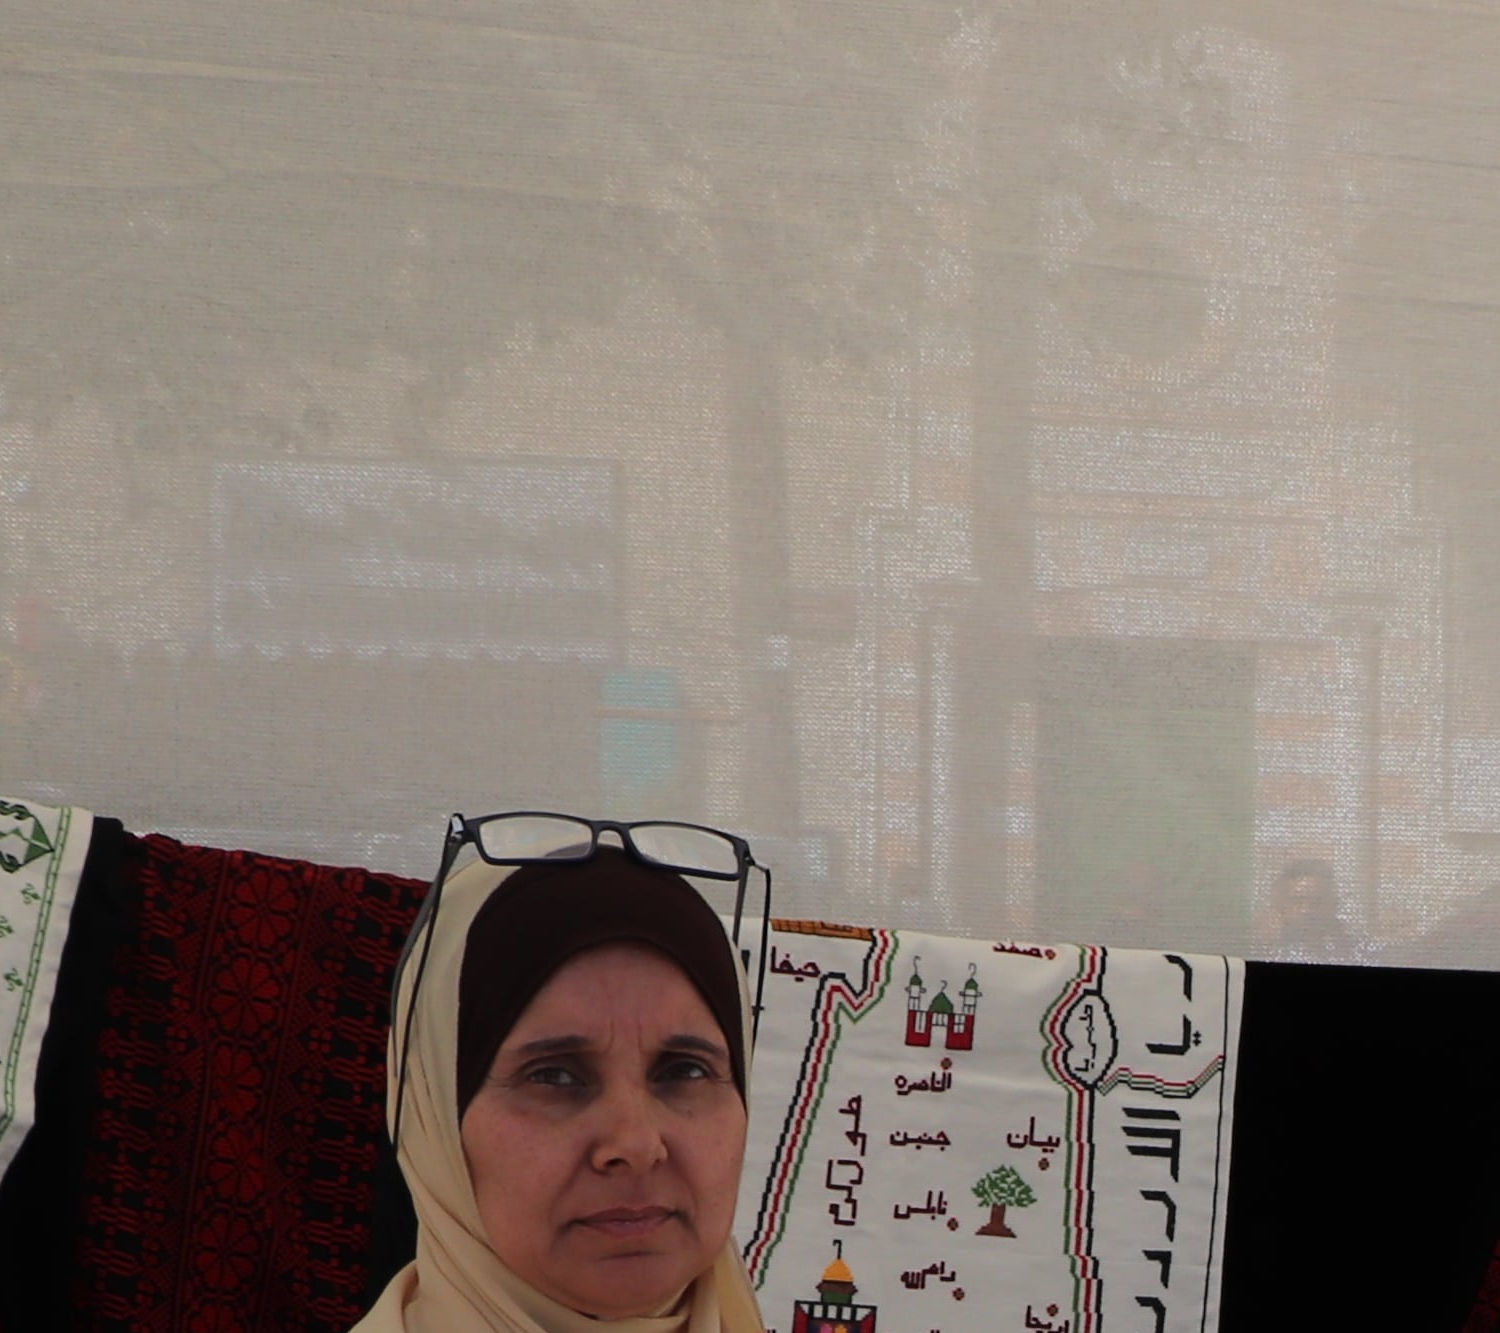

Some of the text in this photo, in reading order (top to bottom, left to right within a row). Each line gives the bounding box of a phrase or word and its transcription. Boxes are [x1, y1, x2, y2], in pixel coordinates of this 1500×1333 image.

[770, 945, 821, 983] حيفا
[889, 1129, 952, 1152] جنين
[892, 1189, 949, 1220] نابلس
